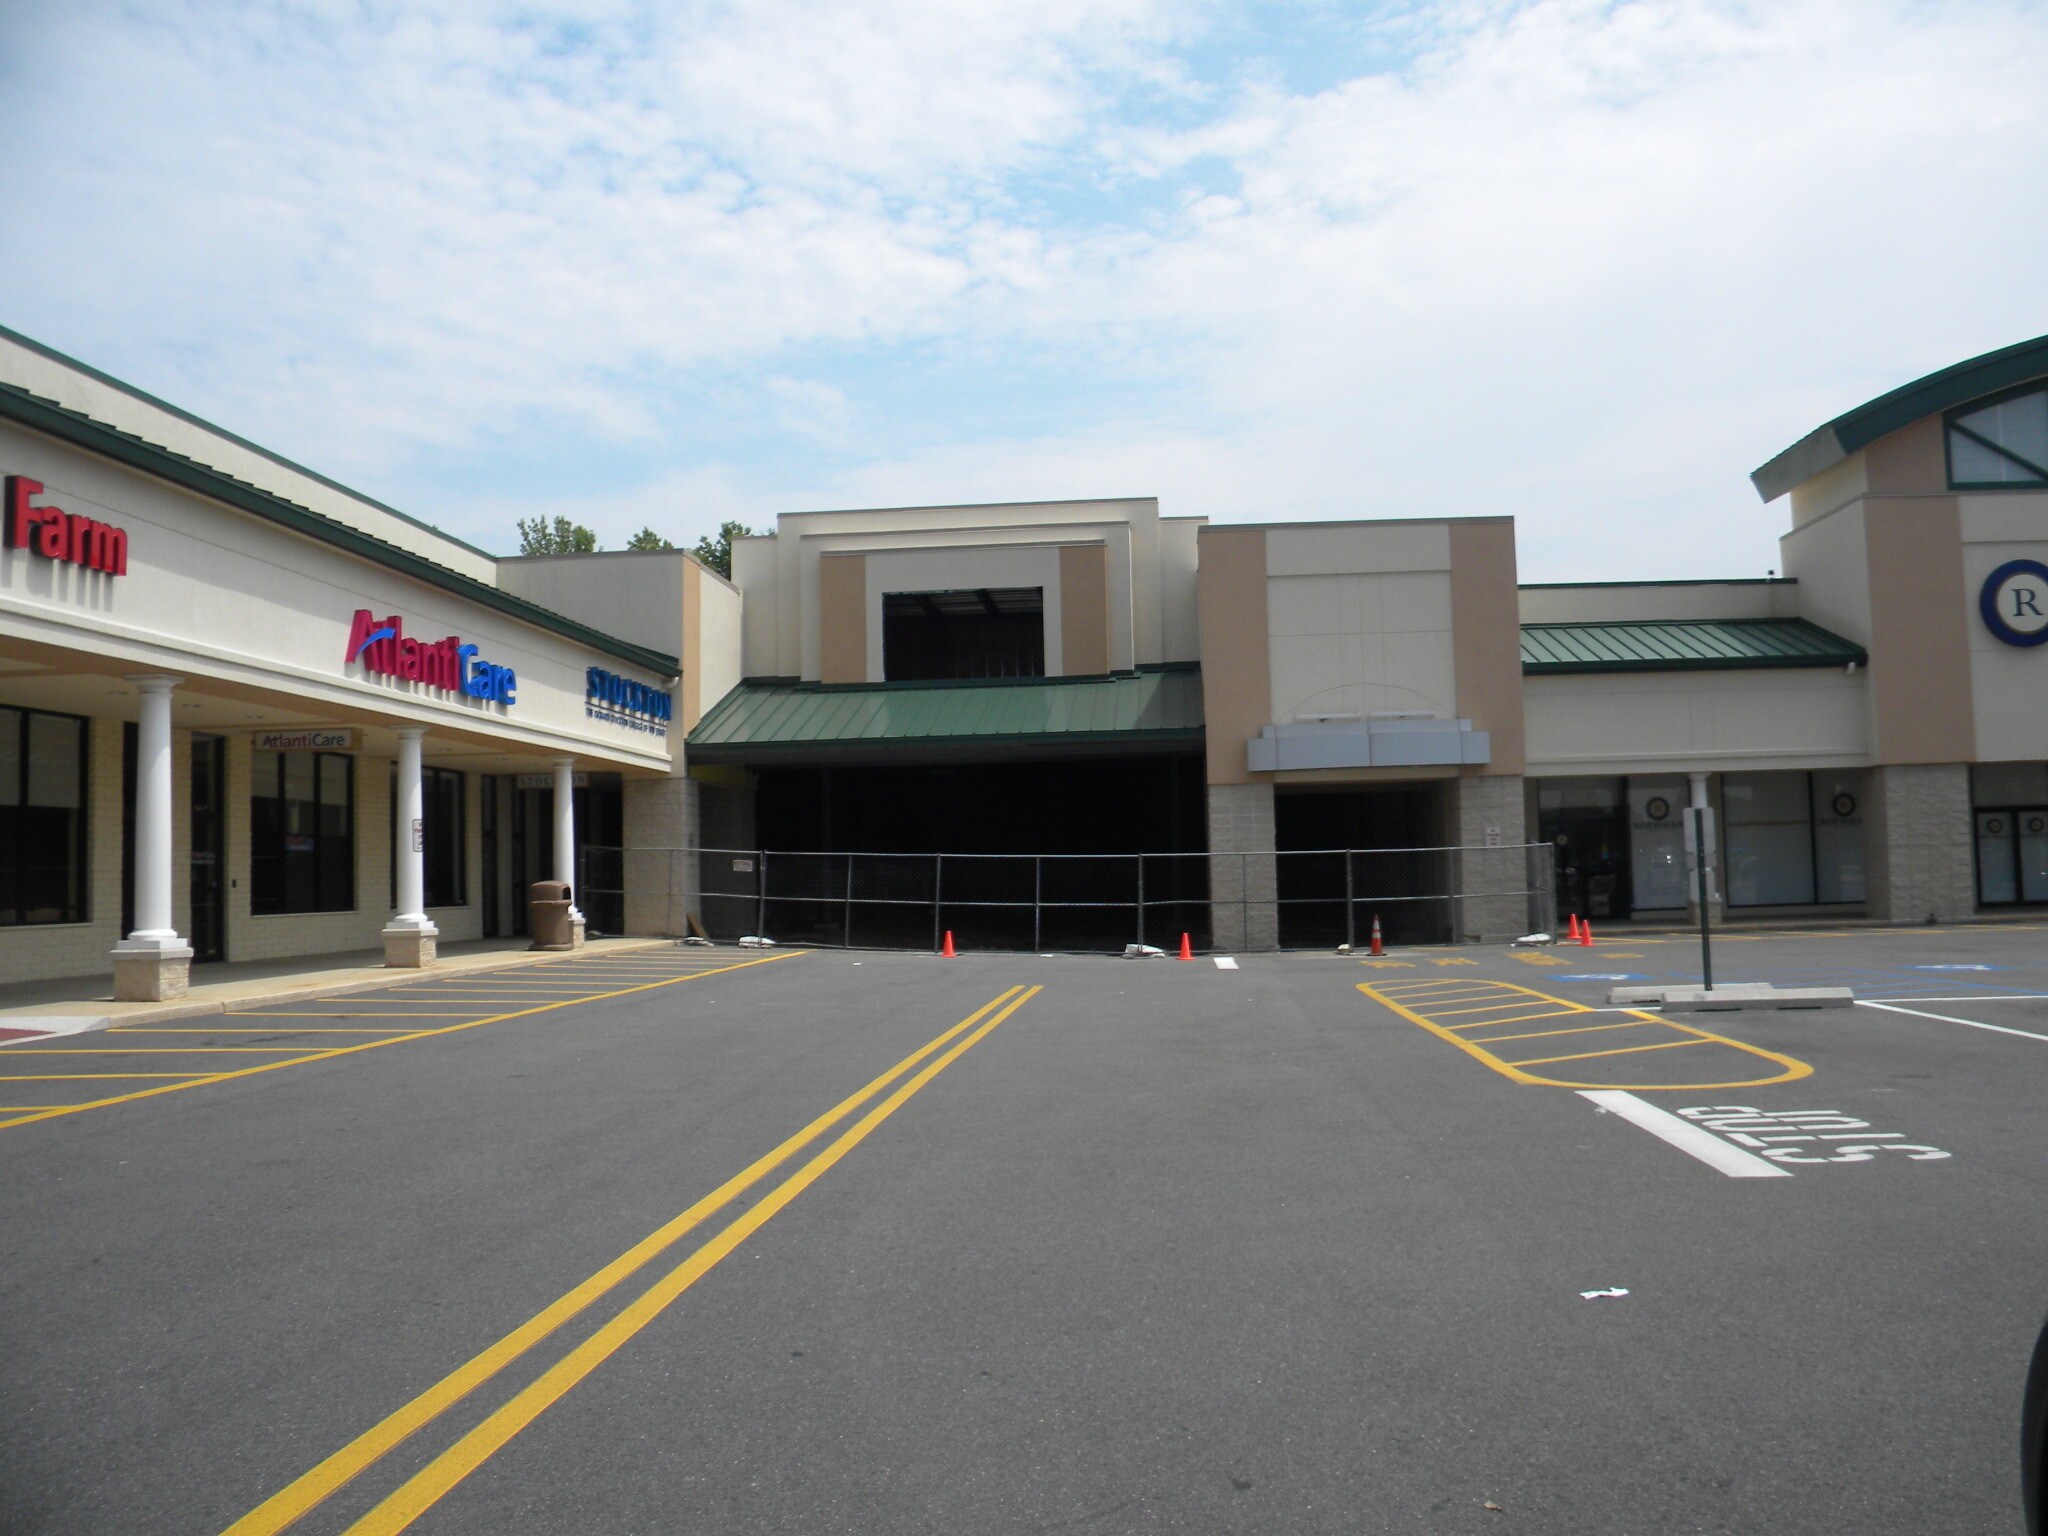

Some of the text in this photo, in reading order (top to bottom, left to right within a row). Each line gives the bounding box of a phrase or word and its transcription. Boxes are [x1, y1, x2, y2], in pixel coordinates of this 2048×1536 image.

[4, 475, 128, 576] Farm
[2011, 588, 2044, 616] R
[345, 609, 517, 705] AtlantiCare
[586, 666, 671, 721] STOCKTON
[263, 733, 345, 748] AtlantiCare
[1676, 1105, 1951, 1163] STOP
